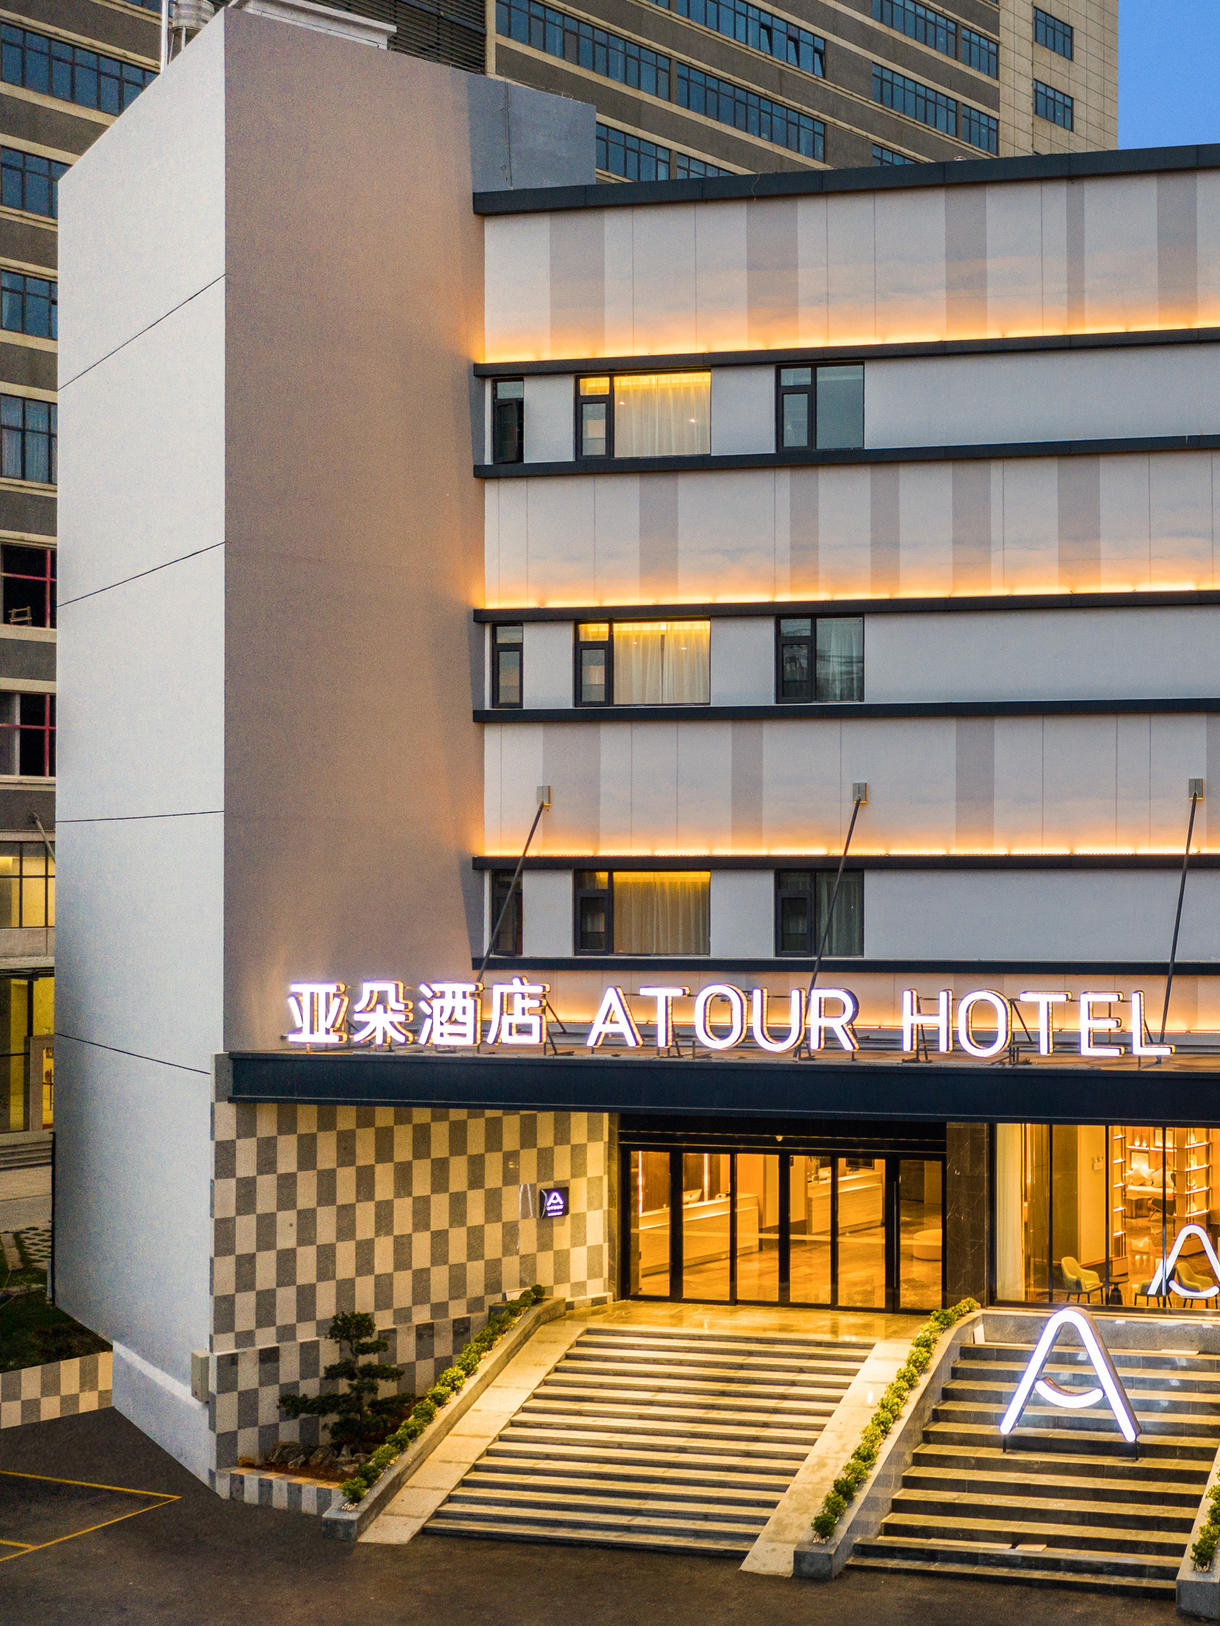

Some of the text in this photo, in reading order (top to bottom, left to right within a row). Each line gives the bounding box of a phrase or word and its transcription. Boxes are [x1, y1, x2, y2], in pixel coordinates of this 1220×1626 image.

[287, 976, 550, 1046] 亚朵酒店
[586, 983, 1177, 1058] ATOUR HOTEL
[999, 1306, 1142, 1443] A
